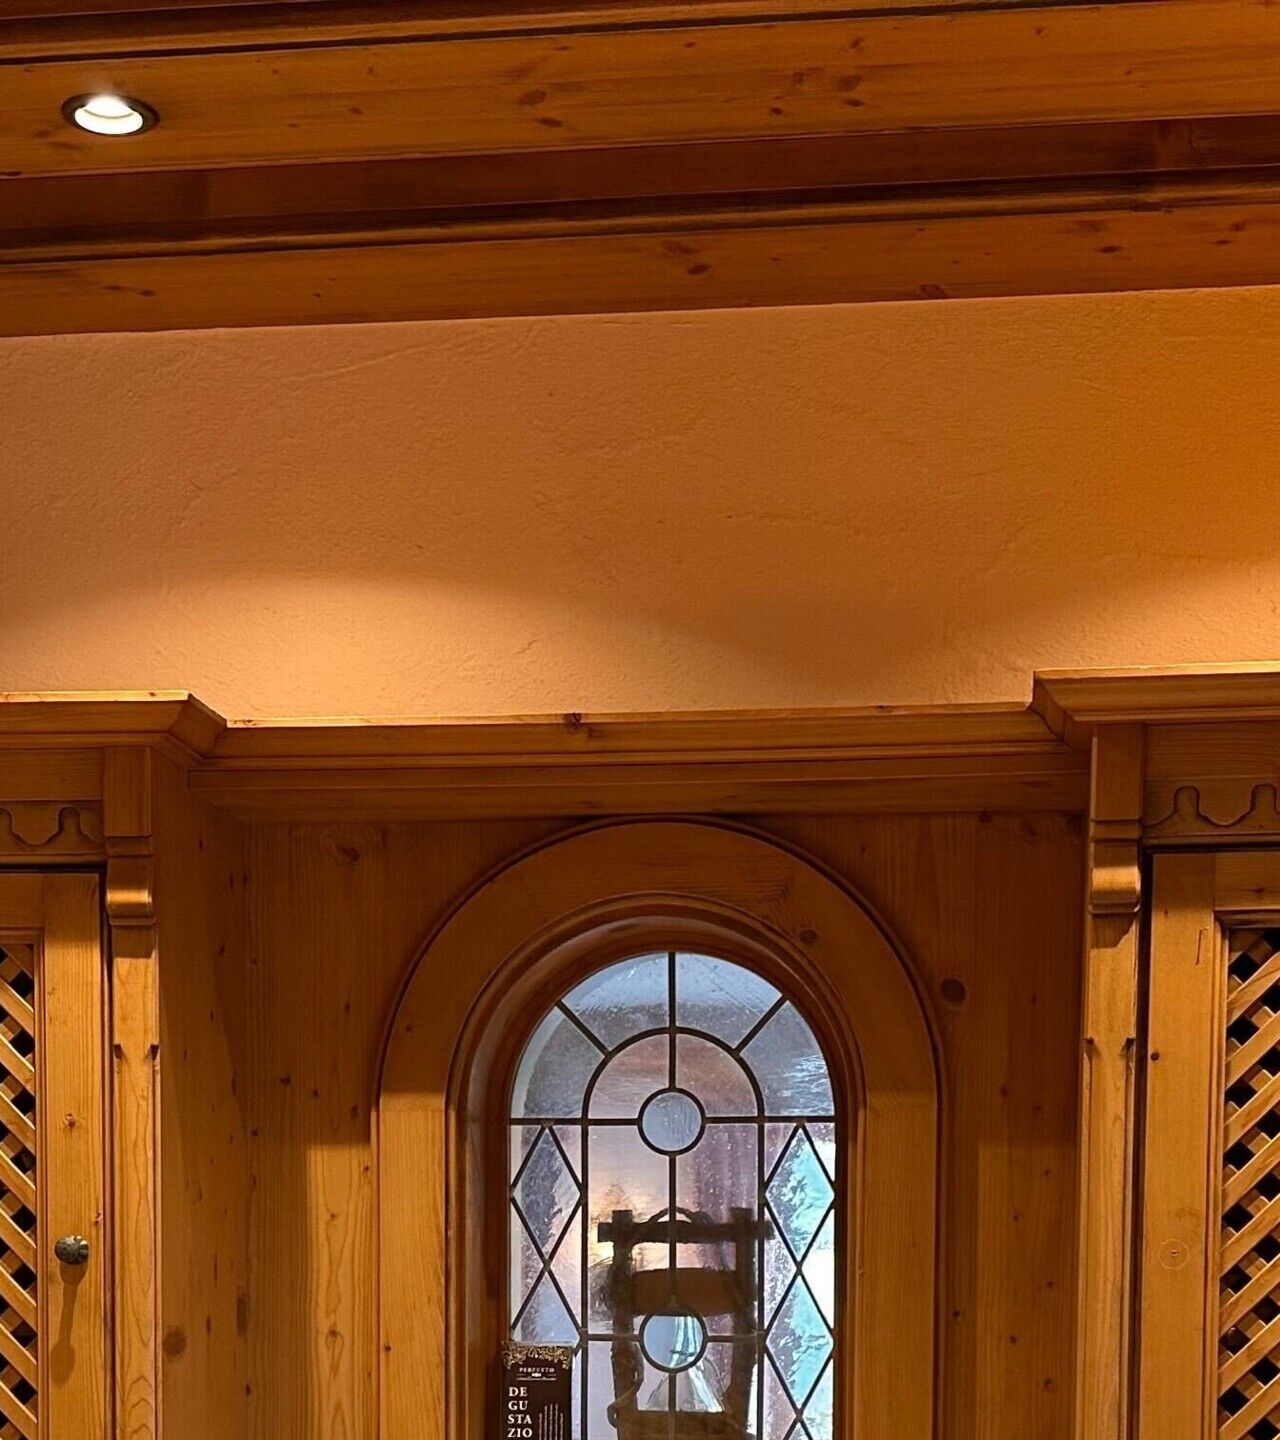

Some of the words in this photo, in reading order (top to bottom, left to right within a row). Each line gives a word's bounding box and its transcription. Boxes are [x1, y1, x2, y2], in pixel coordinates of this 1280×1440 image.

[508, 1387, 528, 1397] DE
[508, 1400, 528, 1411] GU
[507, 1413, 532, 1425] STA
[507, 1427, 533, 1438] ZIO
